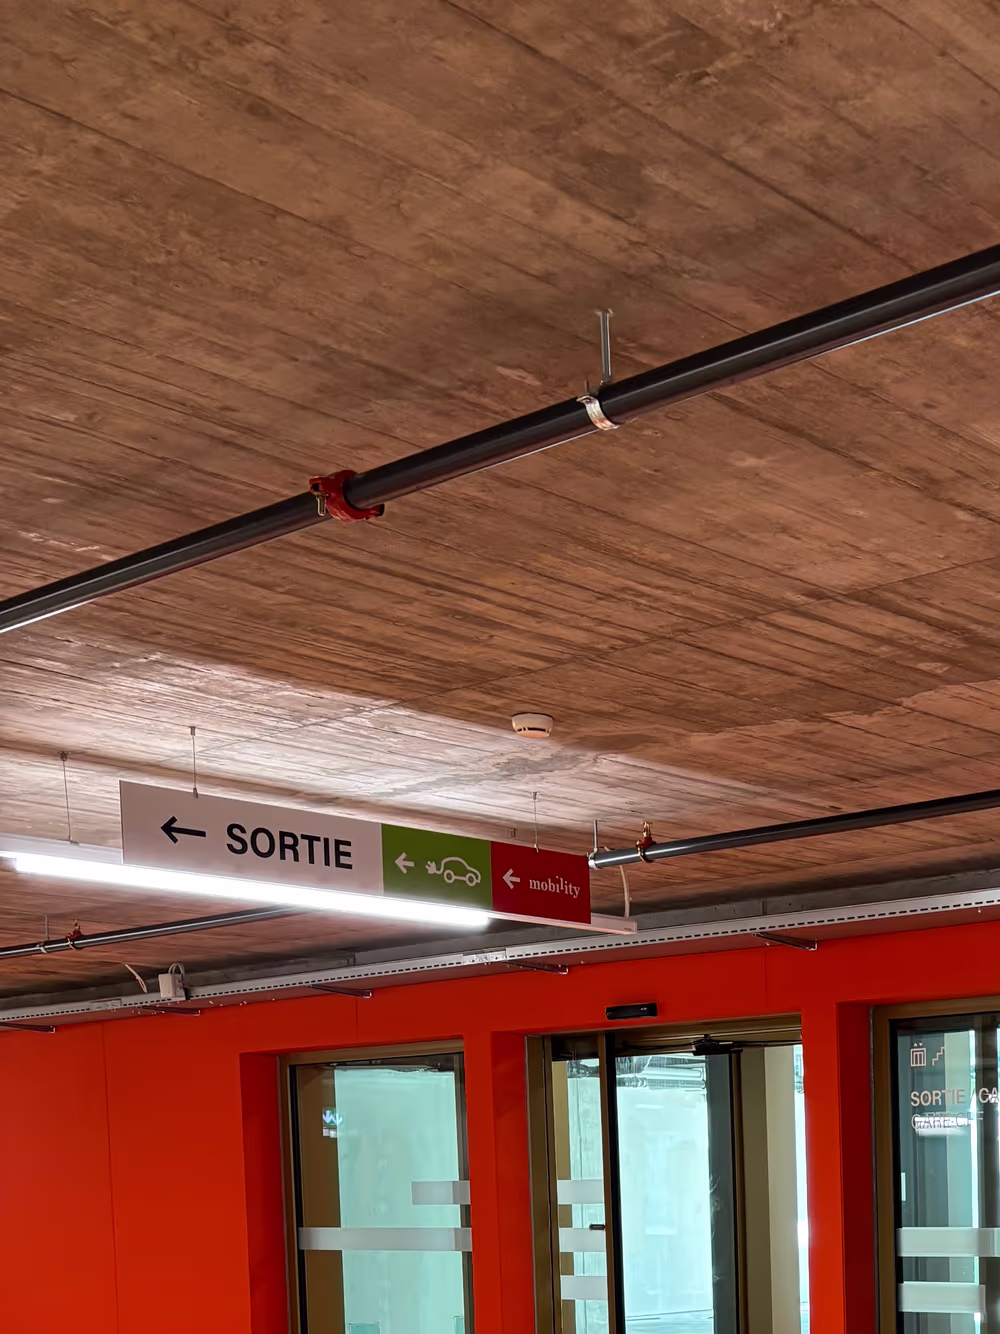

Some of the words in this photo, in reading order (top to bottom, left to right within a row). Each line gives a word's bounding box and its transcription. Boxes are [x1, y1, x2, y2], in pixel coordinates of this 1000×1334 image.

[226, 822, 354, 870] SORTIE
[528, 875, 581, 899] mobility
[910, 1089, 966, 1107] SORTIE
